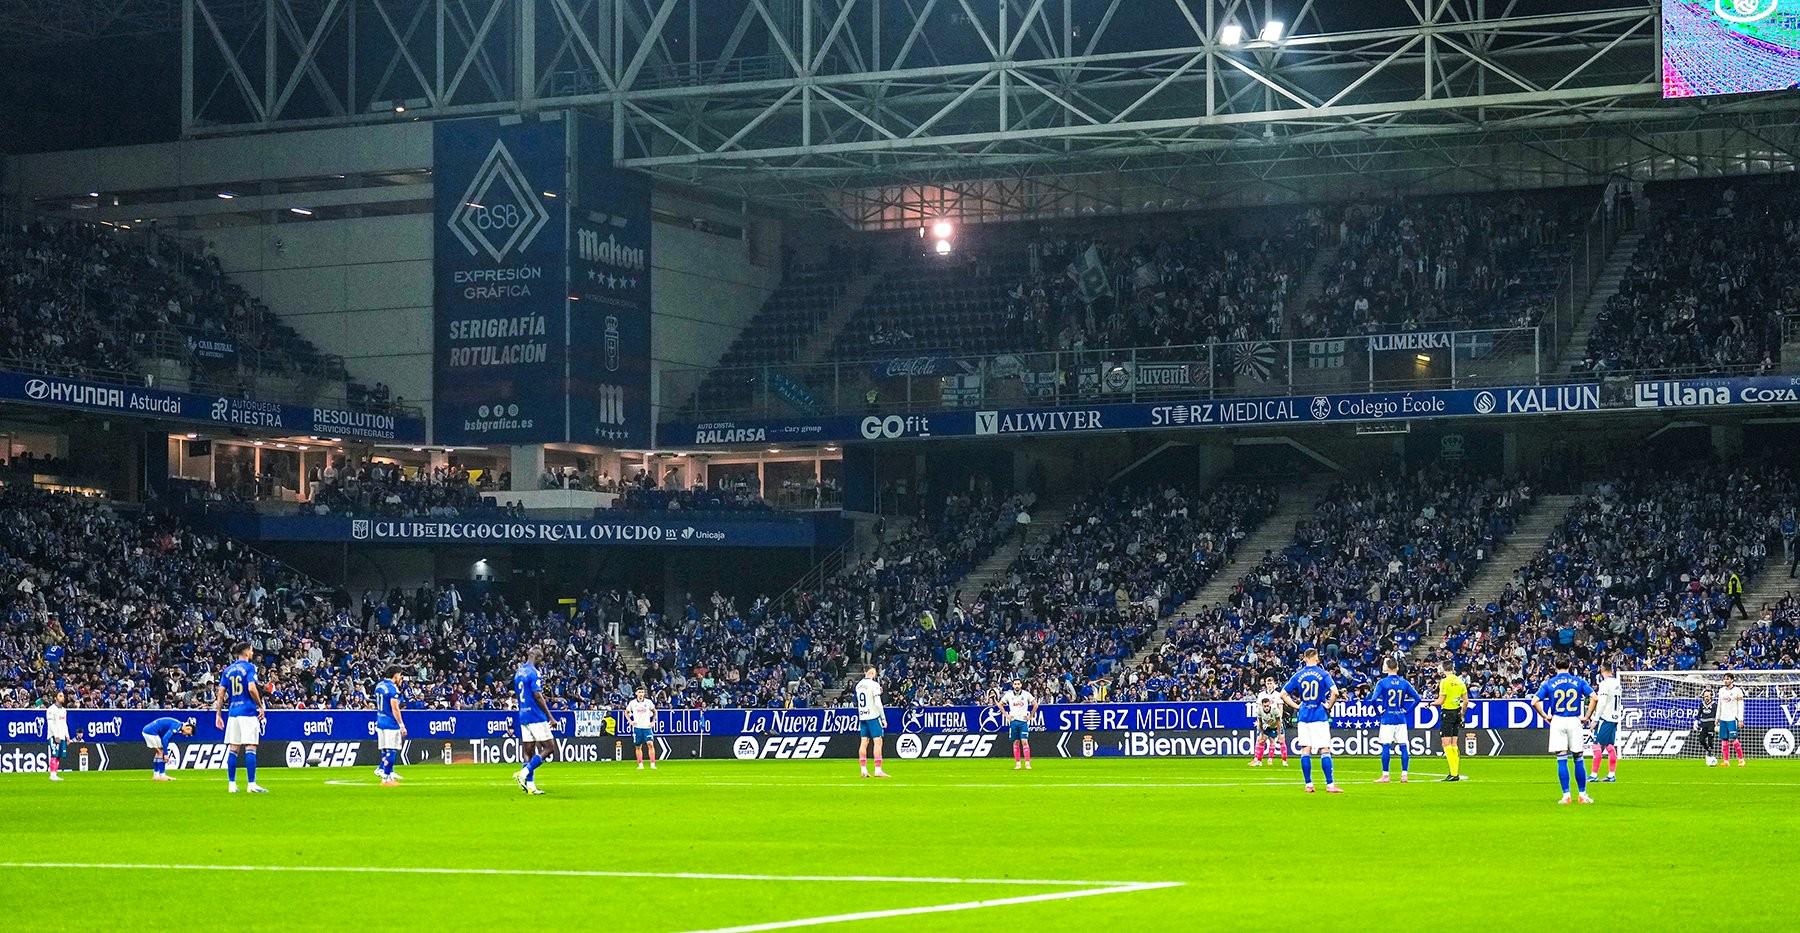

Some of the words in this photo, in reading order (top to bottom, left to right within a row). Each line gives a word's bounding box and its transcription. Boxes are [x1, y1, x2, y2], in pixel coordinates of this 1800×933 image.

[478, 205, 519, 229] BSB
[577, 228, 645, 271] Mahou
[454, 265, 542, 283] EXPRESIÓN
[464, 284, 531, 299] GRÁFICA
[450, 312, 546, 340] SERIGRAFÍA
[1368, 333, 1450, 351] ALIMERKA
[450, 340, 547, 367] ROTULACIÓN
[51, 382, 124, 407] HYUNDAI
[130, 393, 181, 413] Asturdai
[1507, 386, 1600, 413] KALIUN
[1664, 382, 1731, 406] llana
[232, 399, 281, 413] AUTORUEDAS
[1152, 404, 1213, 425] STORZ
[1219, 400, 1300, 422] MEDICAL
[1338, 398, 1398, 417] Colegio
[1402, 393, 1446, 413] École
[231, 409, 282, 427] RIESTRA
[314, 409, 395, 430] RESOLUTION
[464, 419, 533, 433] bsbgrafica.es
[1000, 410, 1103, 433] ALWIVER
[314, 423, 351, 435] SERVICIOS
[352, 428, 395, 439] INTEGRALES
[696, 428, 766, 443] RALARSA
[375, 522, 425, 538] CLUB
[438, 523, 536, 539] NEGOCIOS
[540, 524, 587, 541] REAL
[590, 525, 662, 540] OVIEDO
[666, 529, 677, 540] BY
[695, 531, 726, 541] Unicaja
[230, 675, 243, 696] 16
[1301, 680, 1319, 701] 20
[860, 692, 866, 708] 9
[1388, 688, 1403, 707] 21
[1554, 688, 1578, 712] 22
[741, 710, 765, 733] La
[770, 710, 819, 733] Nueva
[821, 710, 860, 735] Espa
[924, 712, 967, 728] INTEGRA
[1059, 709, 1128, 731] STORZ
[1136, 708, 1225, 730] MEDICAL
[1415, 702, 1489, 729] DGI
[1649, 708, 1685, 719] GRUPO
[1687, 708, 1699, 719] PA
[741, 741, 755, 749] EA
[904, 740, 918, 748] EA
[1770, 733, 1789, 744] EA
[180, 744, 230, 769] FC2
[289, 747, 302, 757] EA
[469, 738, 501, 763] The
[555, 737, 598, 763] Yours
